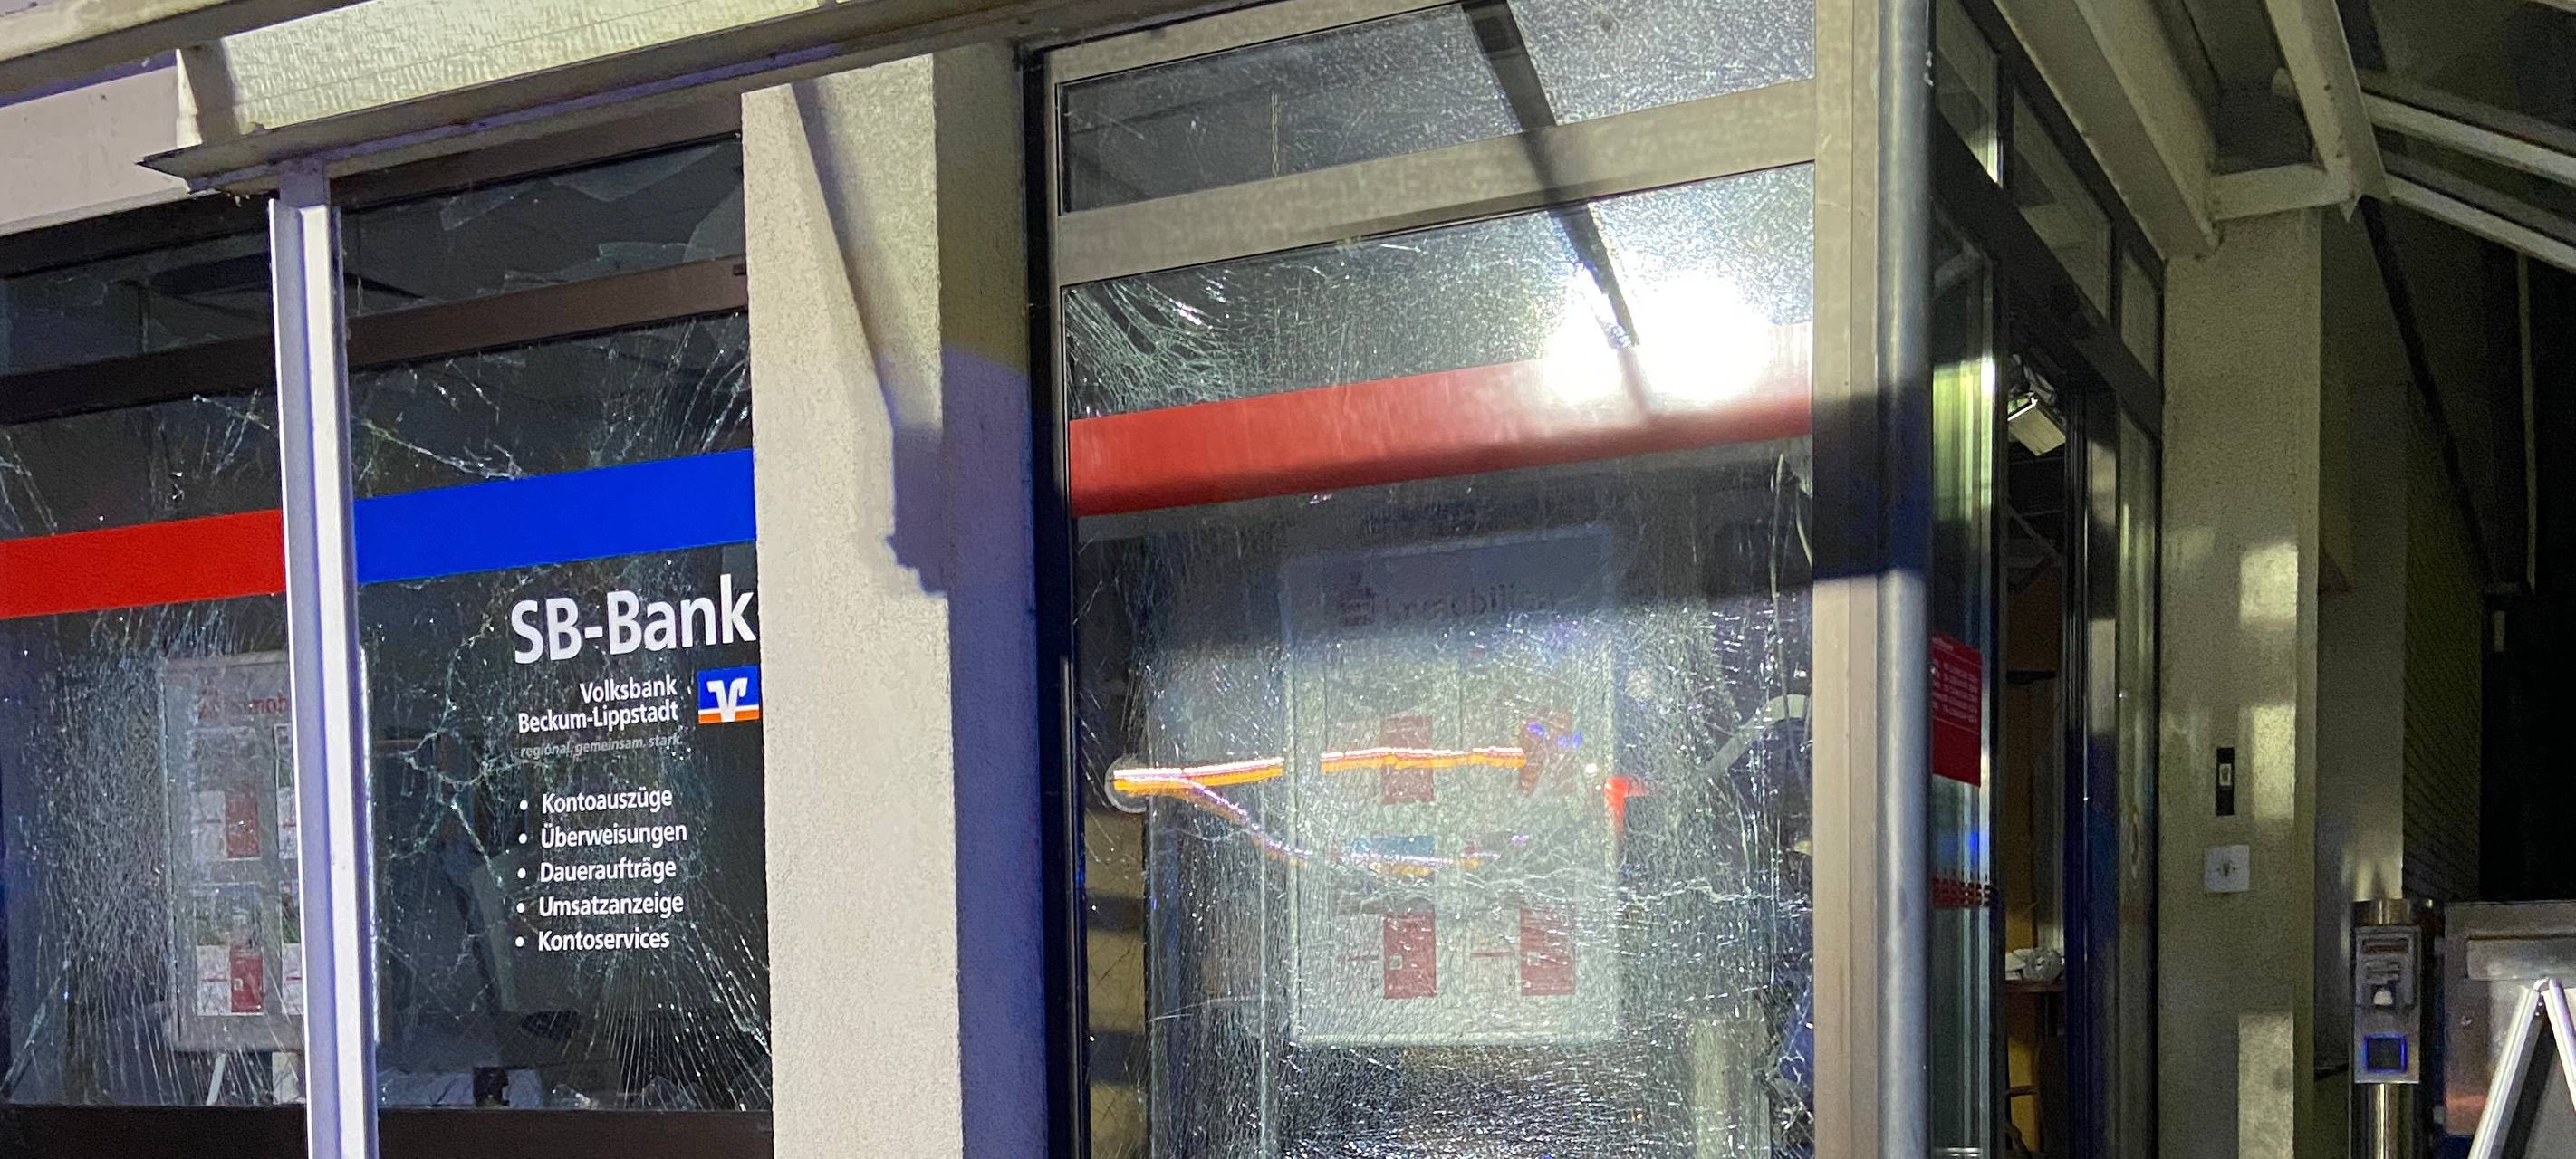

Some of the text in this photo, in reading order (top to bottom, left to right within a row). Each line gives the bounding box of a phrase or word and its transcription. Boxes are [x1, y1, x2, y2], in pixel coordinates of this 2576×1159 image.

[511, 573, 757, 664] SB-Bank
[580, 674, 678, 704] Volksbank
[517, 699, 679, 733] Beckum-Lippstadt
[542, 786, 673, 814] Kontoauszüge
[541, 823, 687, 848] Überweisungen
[540, 857, 677, 884] Daueraufträge
[539, 891, 684, 919] Umsatzanzeige
[538, 927, 670, 952] Kontoservices
